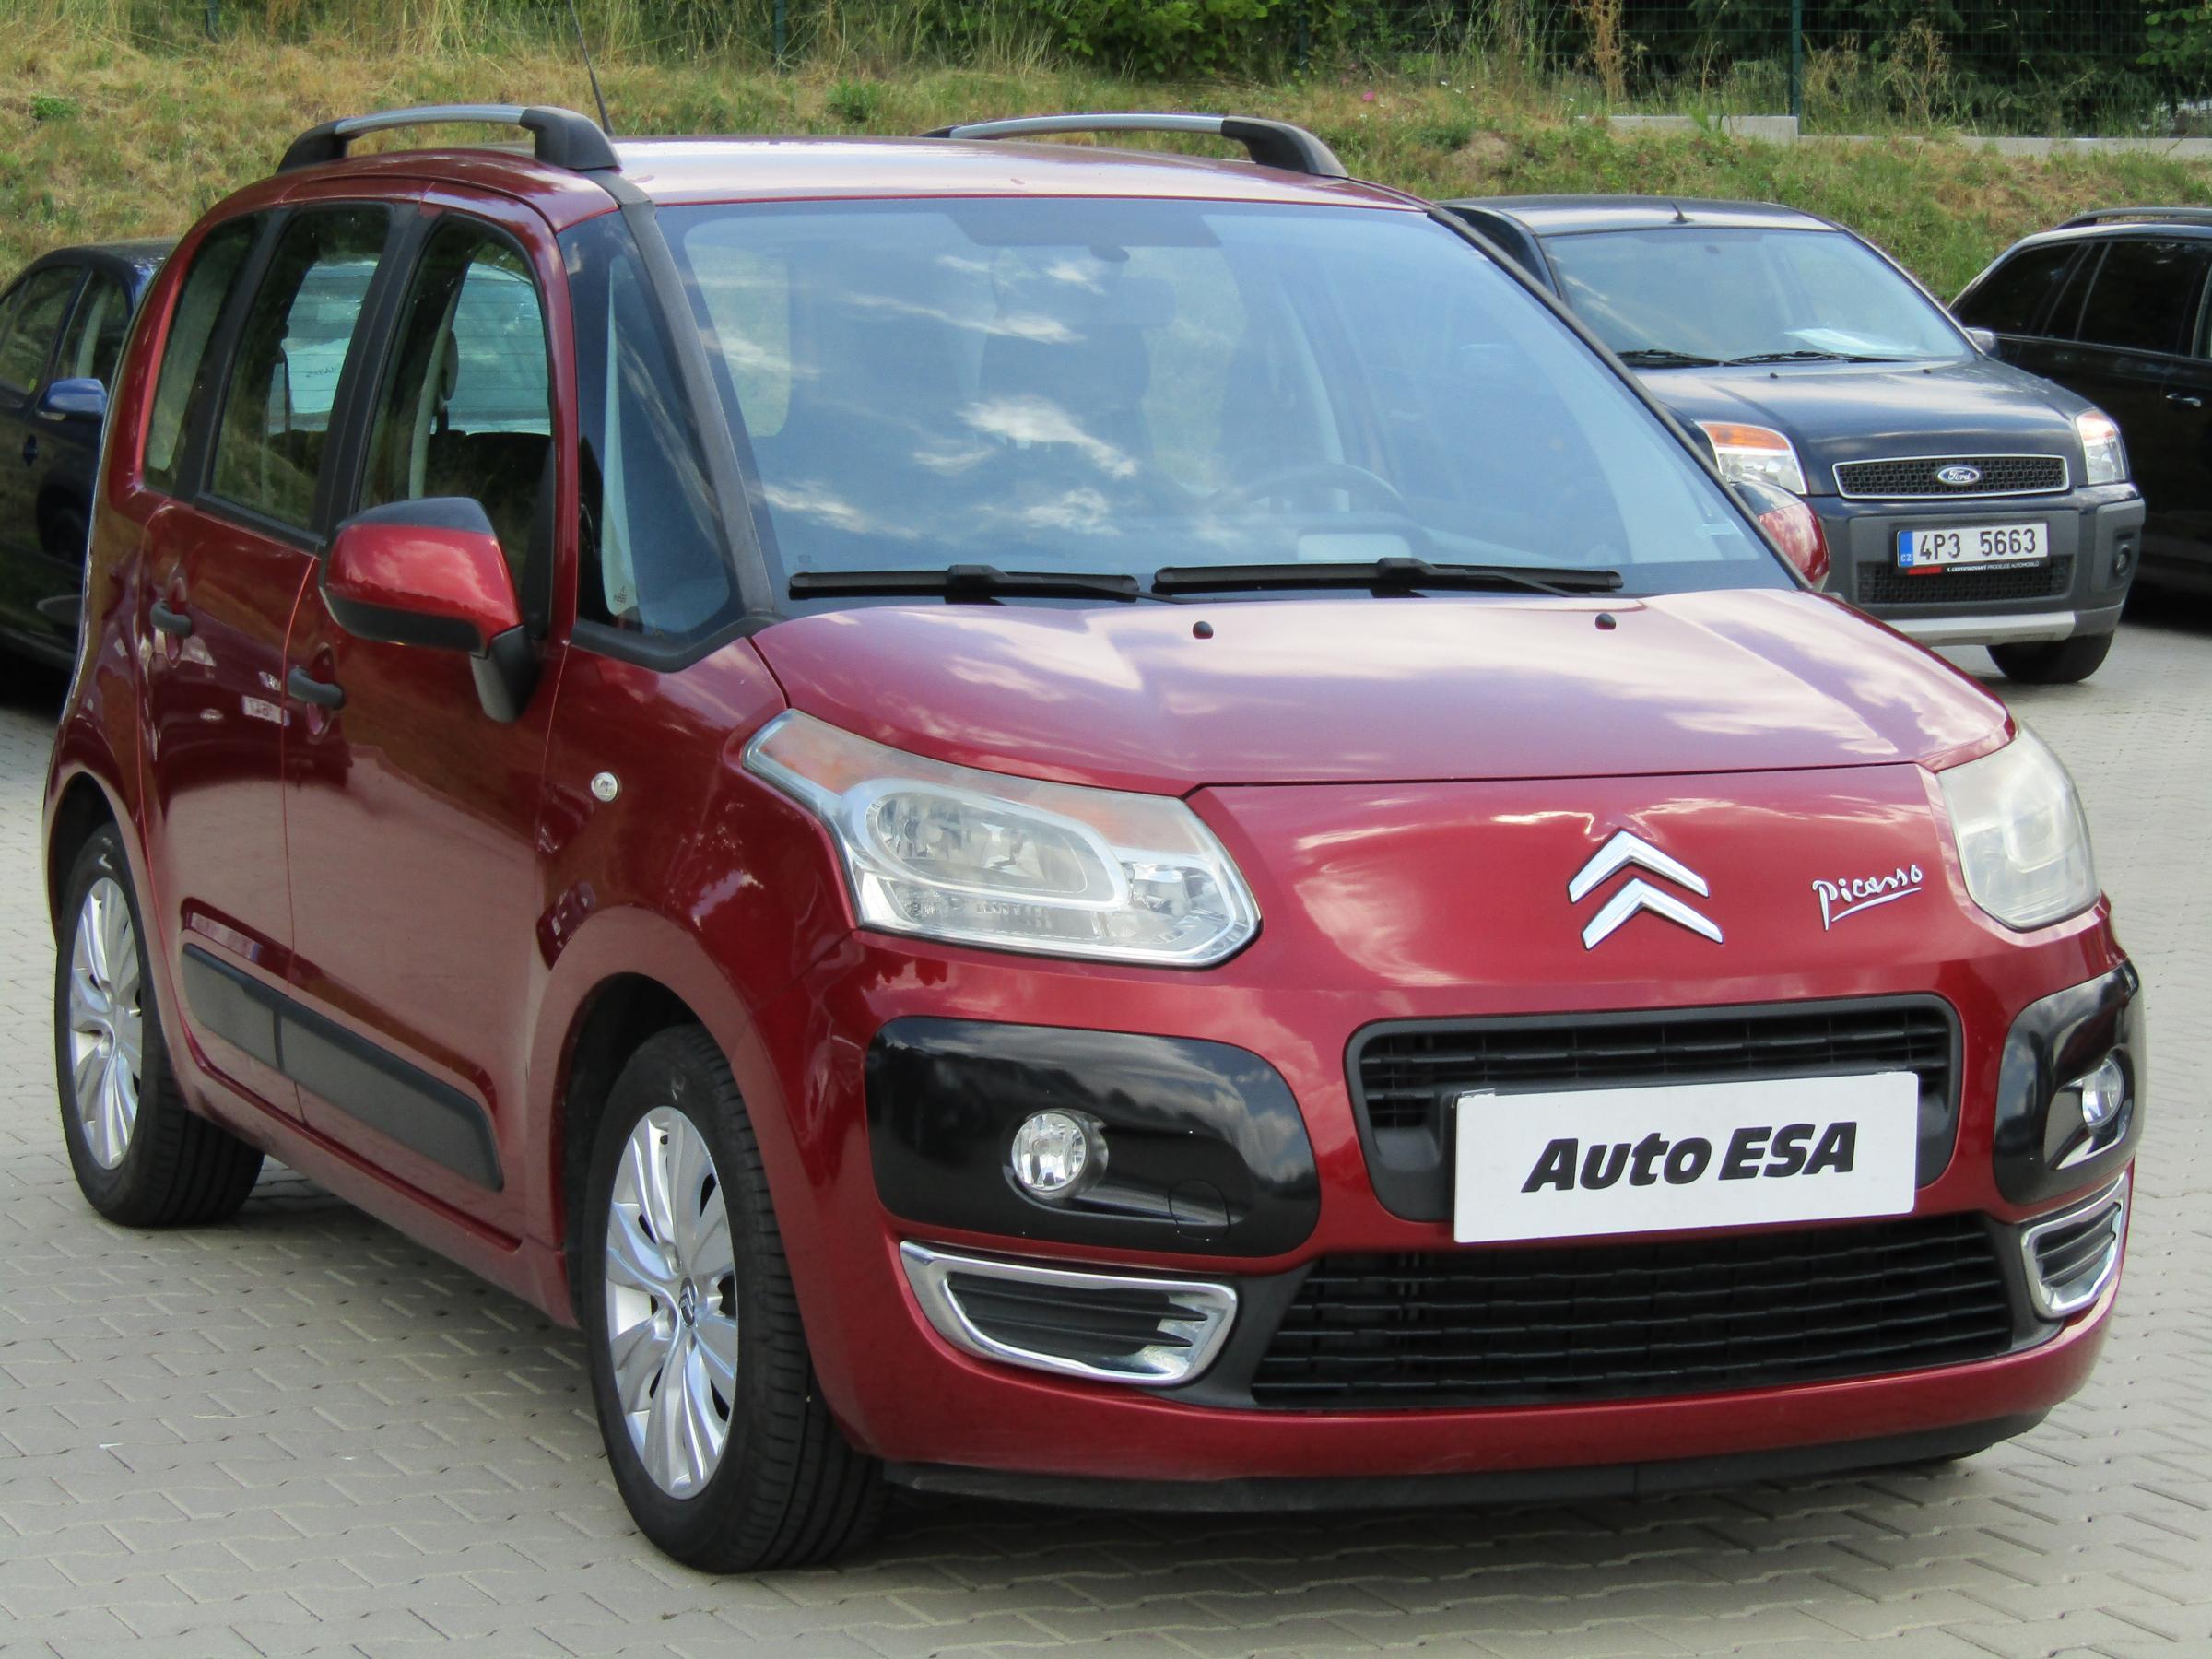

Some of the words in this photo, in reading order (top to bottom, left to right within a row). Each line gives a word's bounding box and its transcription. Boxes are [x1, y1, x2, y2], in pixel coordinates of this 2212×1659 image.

[1947, 470, 1971, 480] Ford
[1919, 533, 1960, 560] 4P3
[1980, 528, 2036, 557] 5663
[1900, 554, 1912, 562] CZ
[1521, 1133, 1712, 1193] Auto
[1718, 1121, 1857, 1182] ESA
